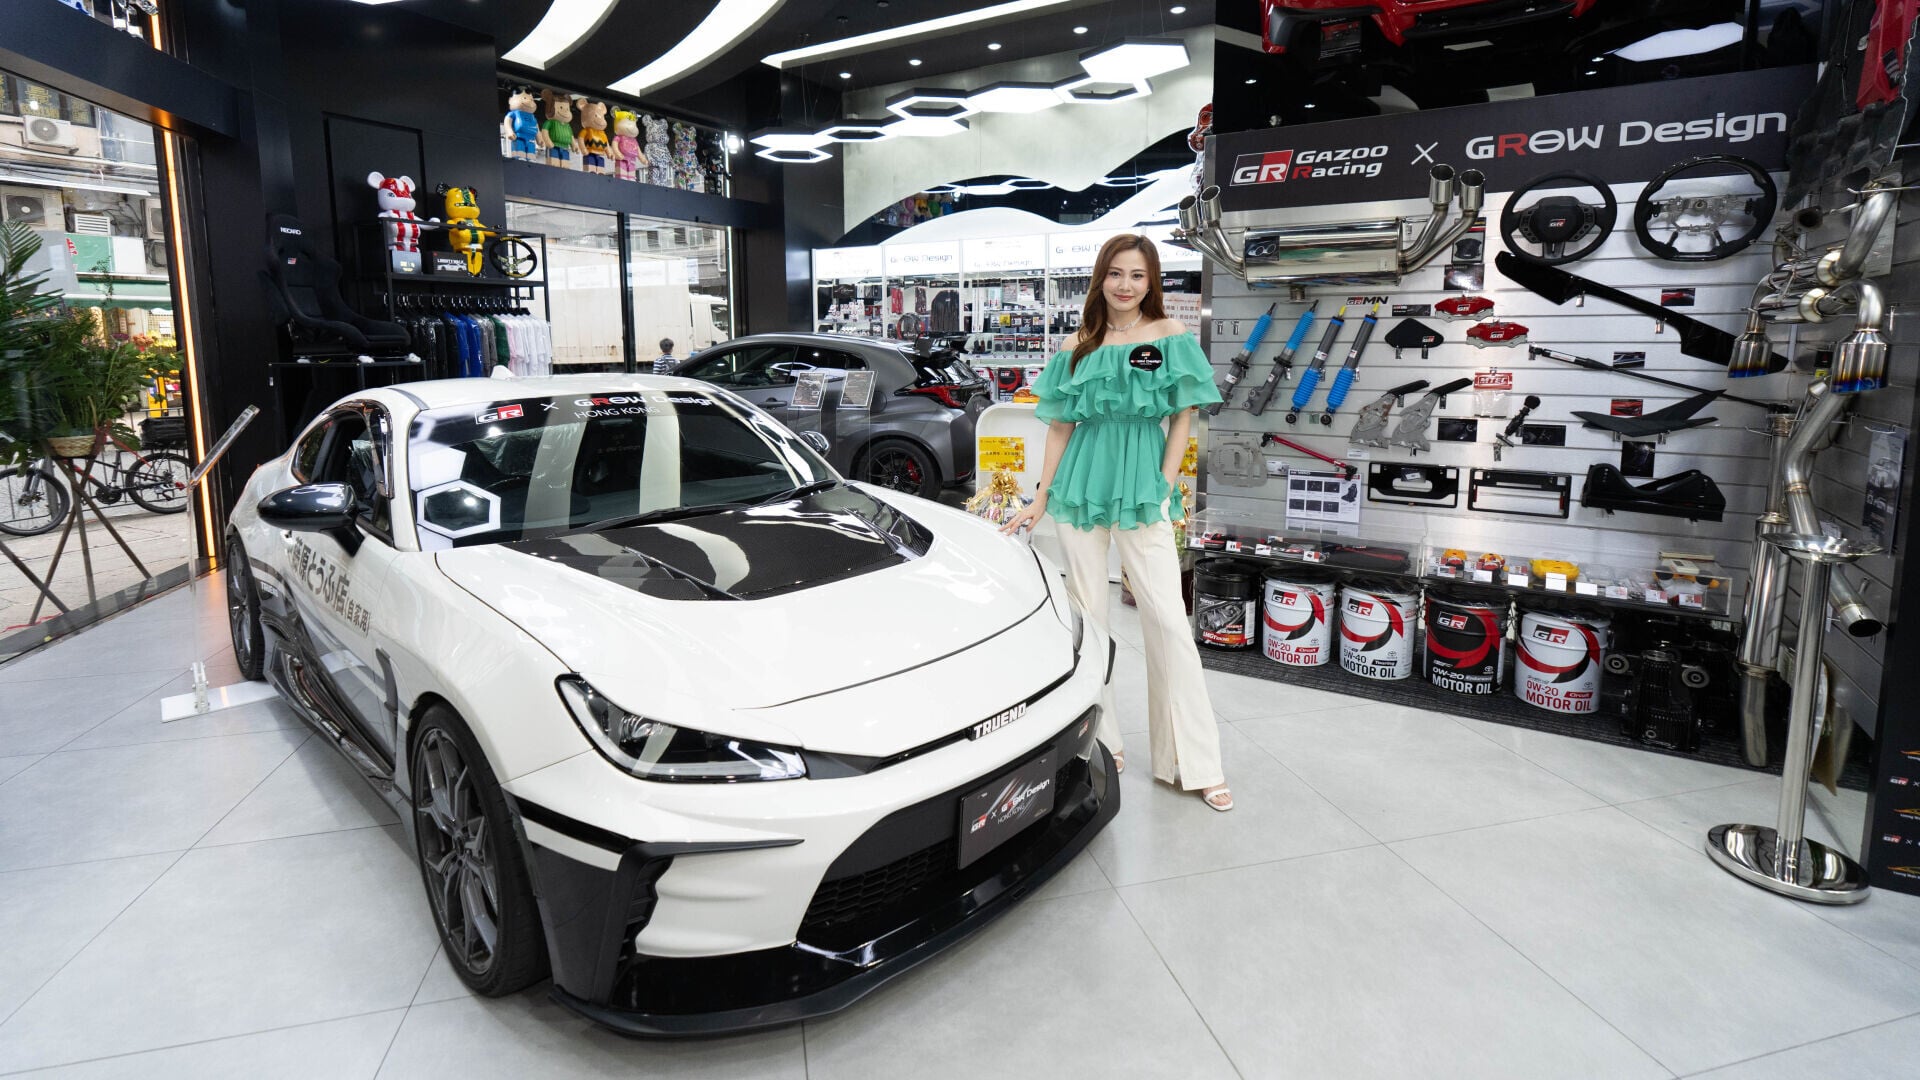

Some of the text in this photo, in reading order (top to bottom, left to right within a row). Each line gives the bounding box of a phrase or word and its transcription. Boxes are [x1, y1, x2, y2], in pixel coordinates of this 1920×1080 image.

[1466, 125, 1604, 160] GROW
[1619, 112, 1787, 147] Design
[1296, 145, 1389, 164] GAZOO
[1232, 159, 1288, 184] GR
[1292, 162, 1383, 179] Racing
[477, 406, 523, 424] GR
[574, 396, 647, 407] GROW
[652, 396, 714, 406] Design
[574, 405, 660, 419] HONG KONG
[1272, 592, 1297, 606] GR
[1349, 602, 1373, 616] GR
[1437, 614, 1467, 630] GR
[1533, 627, 1568, 644] GR
[1268, 647, 1318, 664] MOTOR OIL
[1344, 649, 1367, 664] 5W-40
[1343, 658, 1396, 678] MOTOR OIL
[1432, 673, 1492, 694] MOTOR OIL
[1526, 690, 1591, 711] MOTOR OIL
[973, 702, 1027, 739] TRUENO
[971, 817, 987, 833] GR
[1026, 779, 1050, 797] Design
